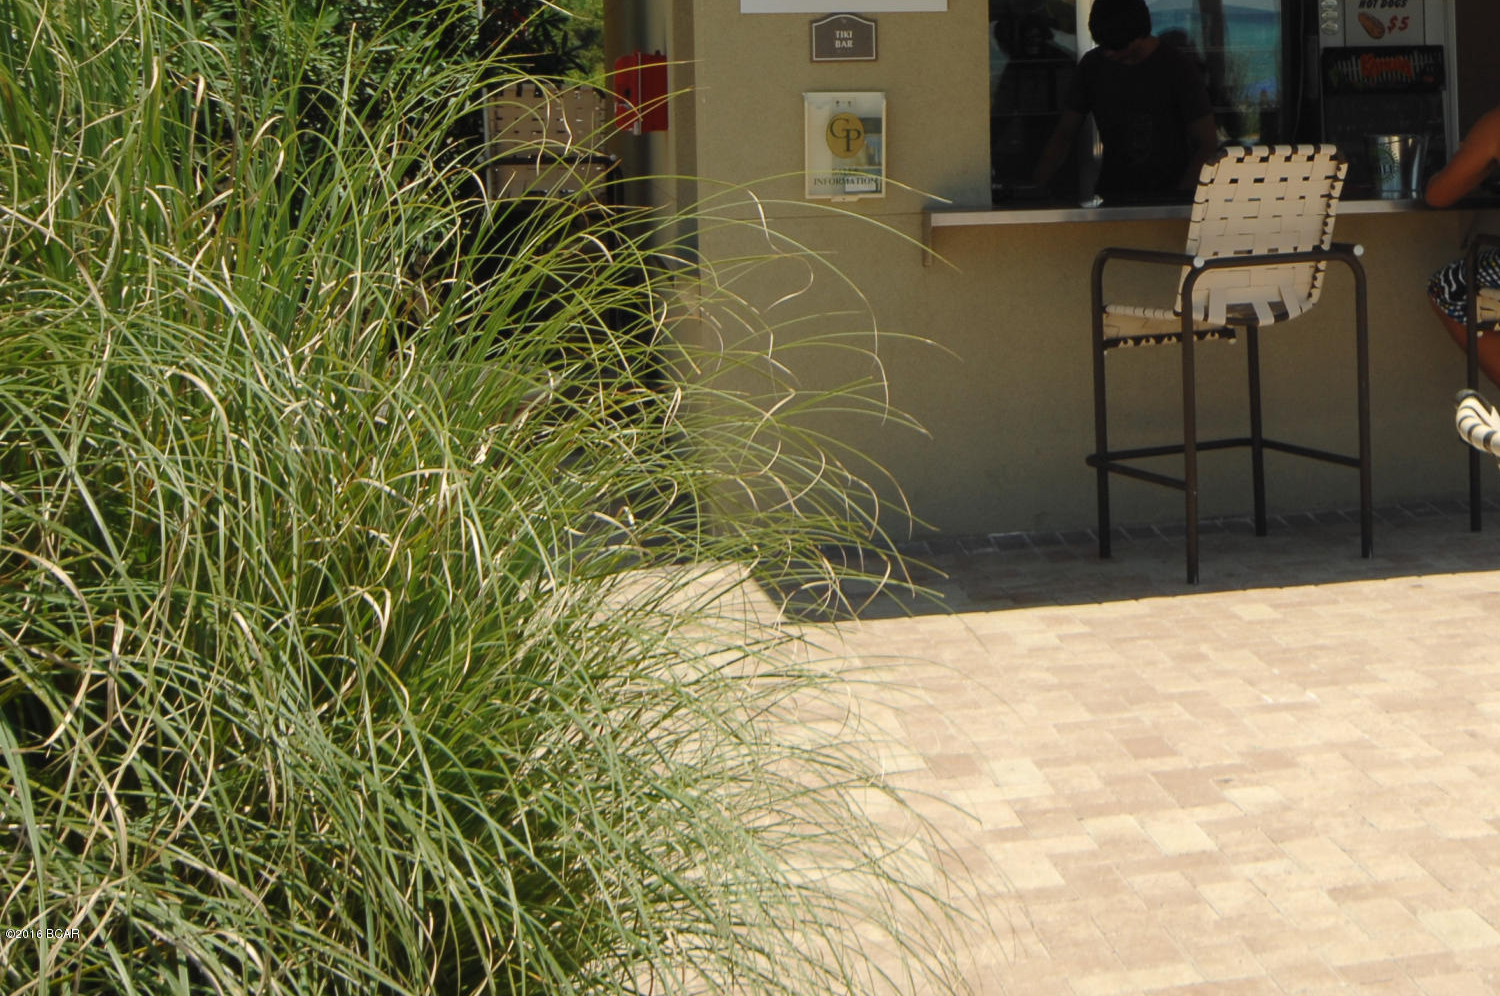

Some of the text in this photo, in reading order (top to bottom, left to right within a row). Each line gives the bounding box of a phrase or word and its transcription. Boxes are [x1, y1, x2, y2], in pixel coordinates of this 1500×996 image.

[1386, 15, 1410, 34] $5
[834, 30, 853, 39] TIKI
[834, 39, 854, 48] BAR
